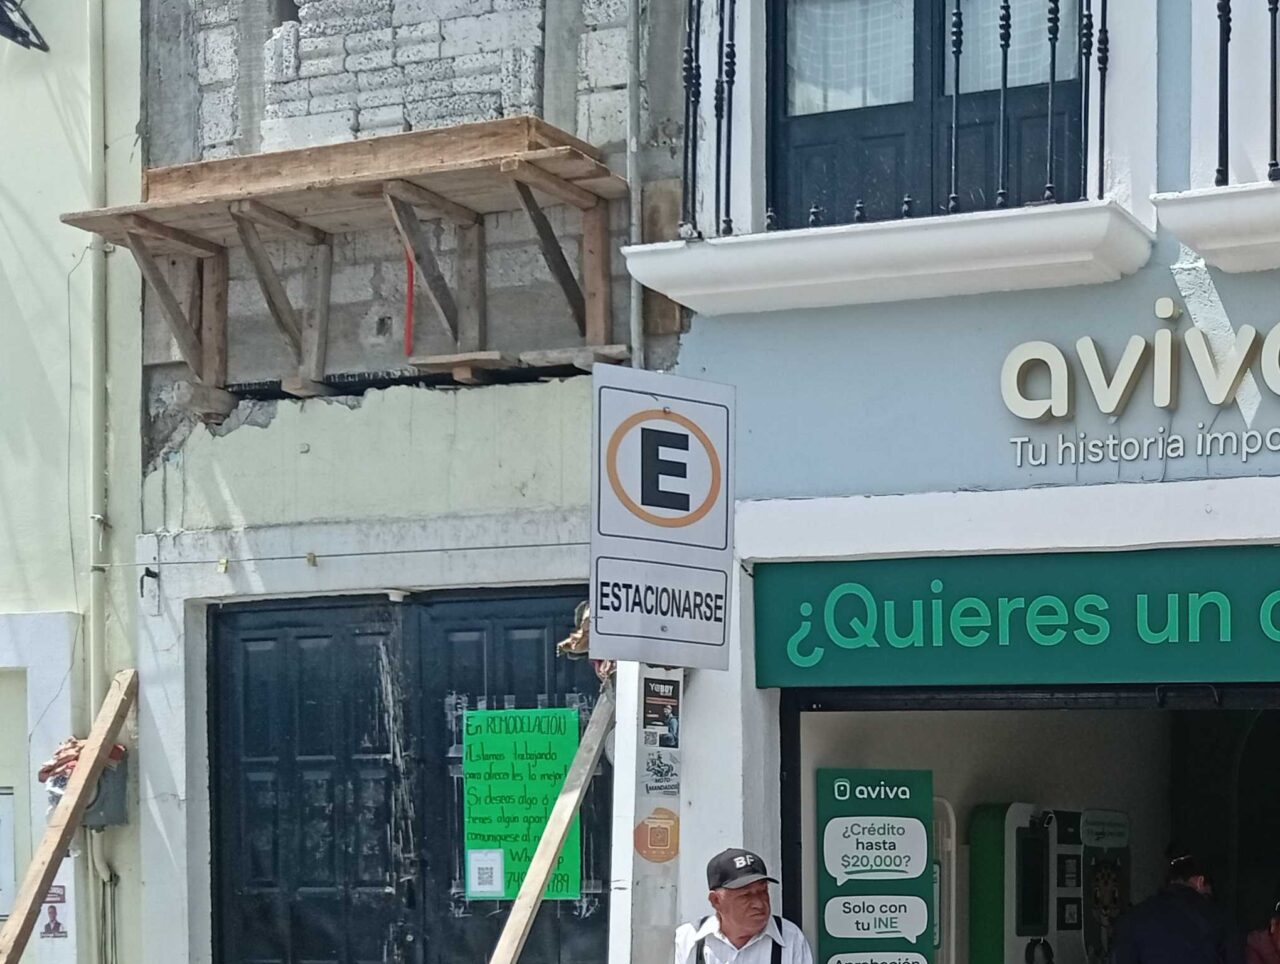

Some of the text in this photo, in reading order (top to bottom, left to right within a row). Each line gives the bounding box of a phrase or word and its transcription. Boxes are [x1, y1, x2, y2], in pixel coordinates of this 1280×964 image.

[1010, 436, 1046, 468] Tu
[1057, 426, 1185, 465] historia
[641, 427, 690, 511] E
[599, 581, 724, 622] ESTACIONARSE
[786, 579, 1111, 668] ¿Quieres
[1136, 589, 1232, 644] un
[518, 784, 538, 810] algo
[855, 781, 911, 799] aviva
[842, 823, 905, 839] ¿Crédito
[855, 838, 896, 851] hasta
[841, 854, 911, 871] $20,000?
[842, 901, 907, 914] Solo con
[855, 917, 898, 931] tu INE
